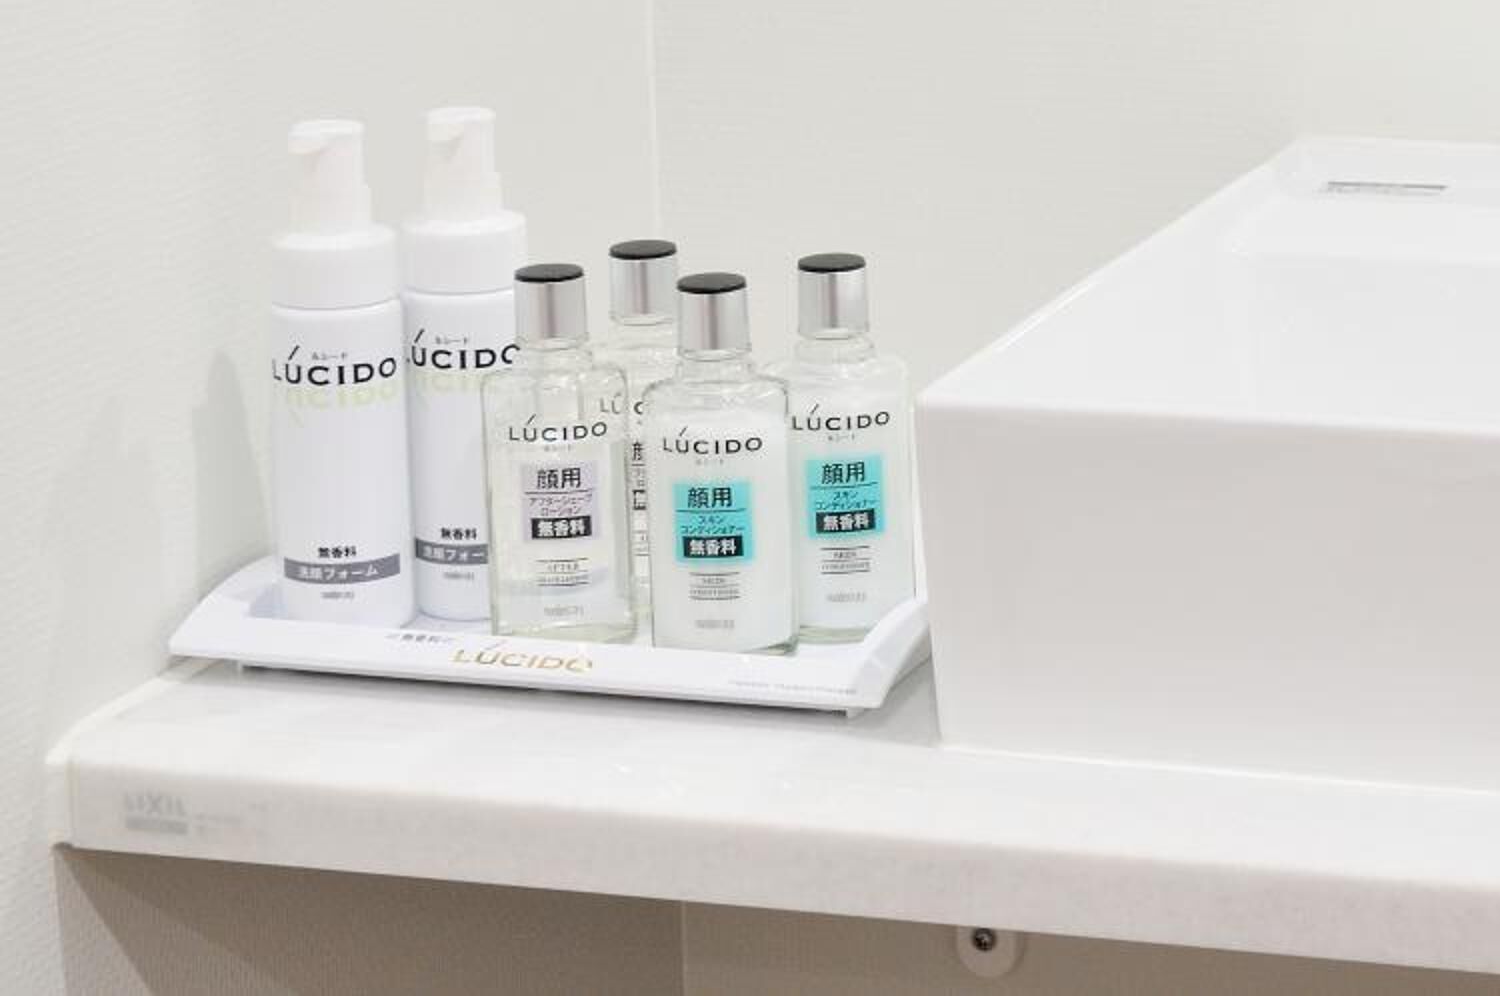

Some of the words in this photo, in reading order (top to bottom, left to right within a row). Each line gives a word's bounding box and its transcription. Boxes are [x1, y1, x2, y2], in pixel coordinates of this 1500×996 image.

[271, 344, 398, 386] LÚCIDO
[508, 413, 608, 443] LÚCIDO
[791, 403, 891, 431] LÚCIDO
[662, 425, 764, 455] LÚCIDO
[536, 467, 582, 490] 顔用
[821, 461, 865, 485] 顔用
[687, 486, 733, 508] 顔用
[536, 519, 586, 537] 無香料
[822, 511, 870, 532] 無香料
[689, 538, 738, 556] 無香料
[452, 639, 594, 673] LÚCIDO
